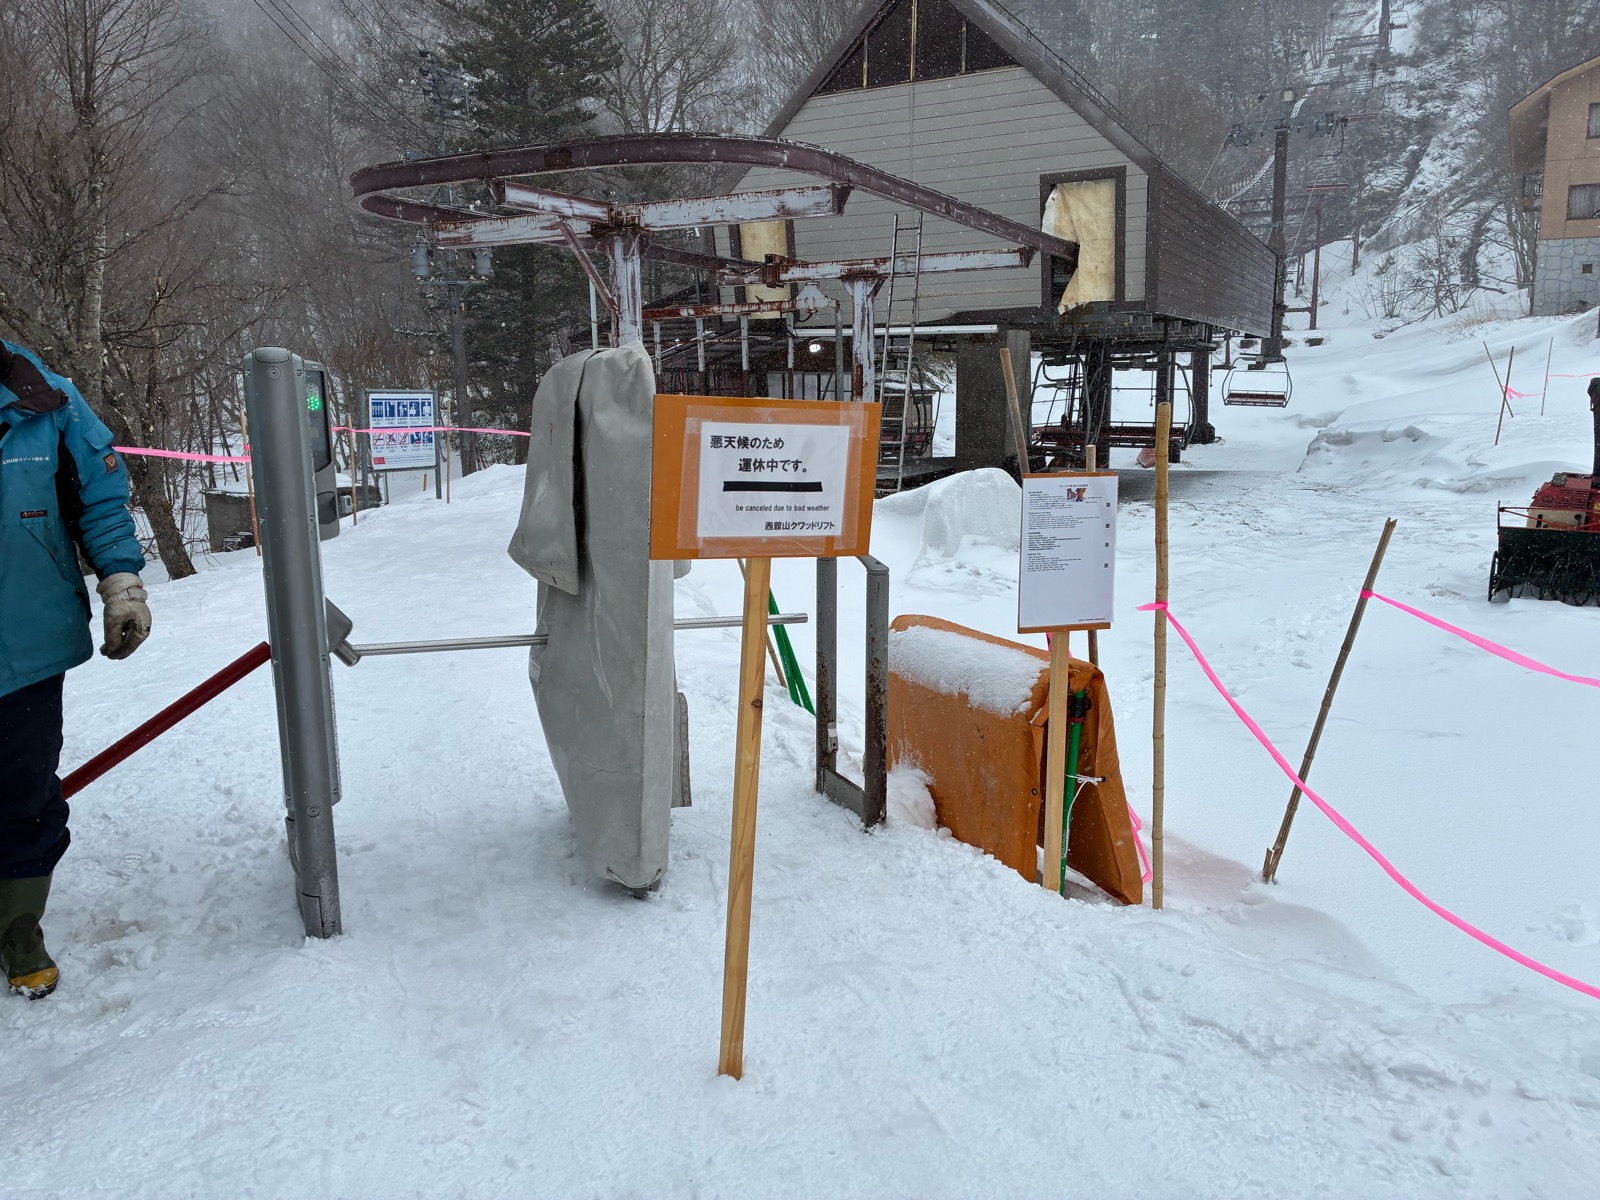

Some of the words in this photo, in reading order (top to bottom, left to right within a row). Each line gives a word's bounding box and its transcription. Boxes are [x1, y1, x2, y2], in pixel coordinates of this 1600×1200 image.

[710, 435, 784, 449] 悪天候のため
[738, 458, 807, 473] 運休中です。
[735, 504, 744, 512] be
[745, 504, 772, 512] canceled
[773, 504, 785, 512] due
[786, 504, 793, 512] to
[794, 504, 805, 512] bad
[806, 504, 830, 512] weather
[765, 521, 835, 531] 西館山クワッドリフト
